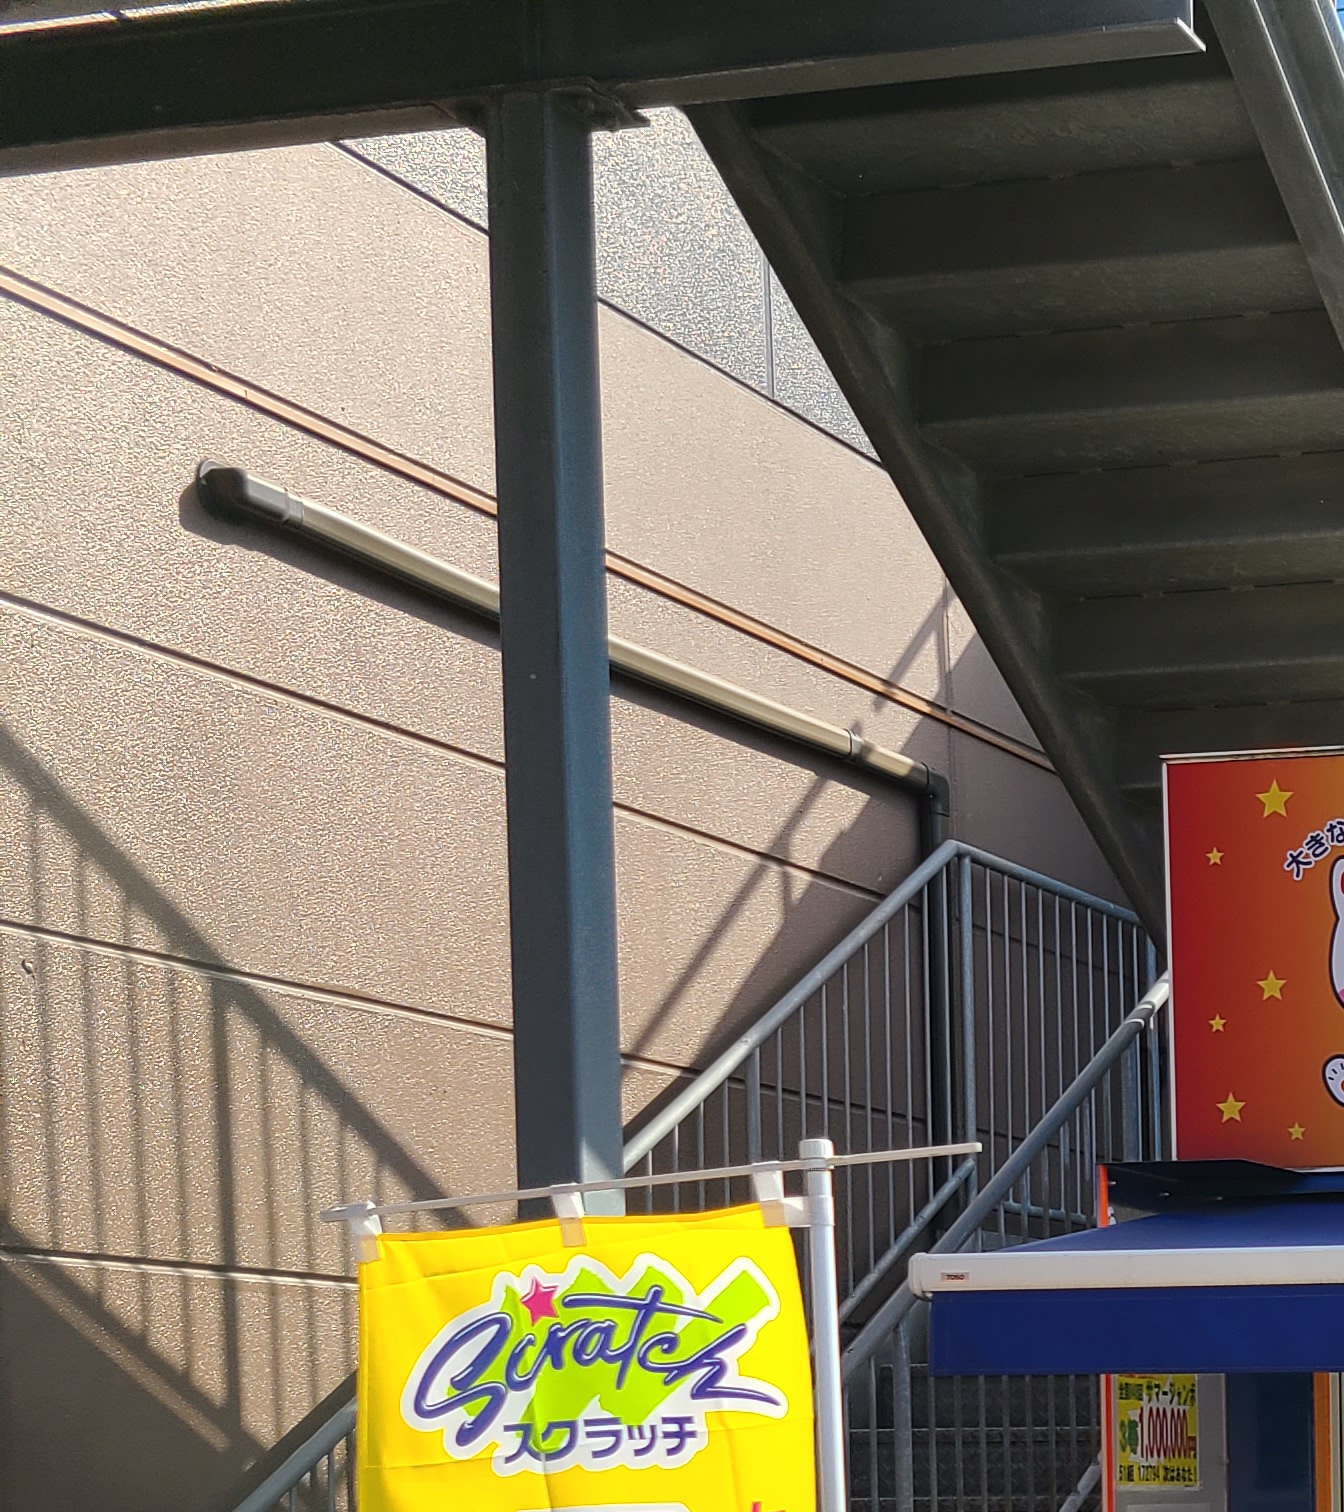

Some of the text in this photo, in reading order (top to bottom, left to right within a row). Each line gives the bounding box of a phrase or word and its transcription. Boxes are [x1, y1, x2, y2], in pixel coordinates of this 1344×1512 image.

[411, 1284, 785, 1449] Scratch
[502, 1414, 700, 1467] スクラッチ
